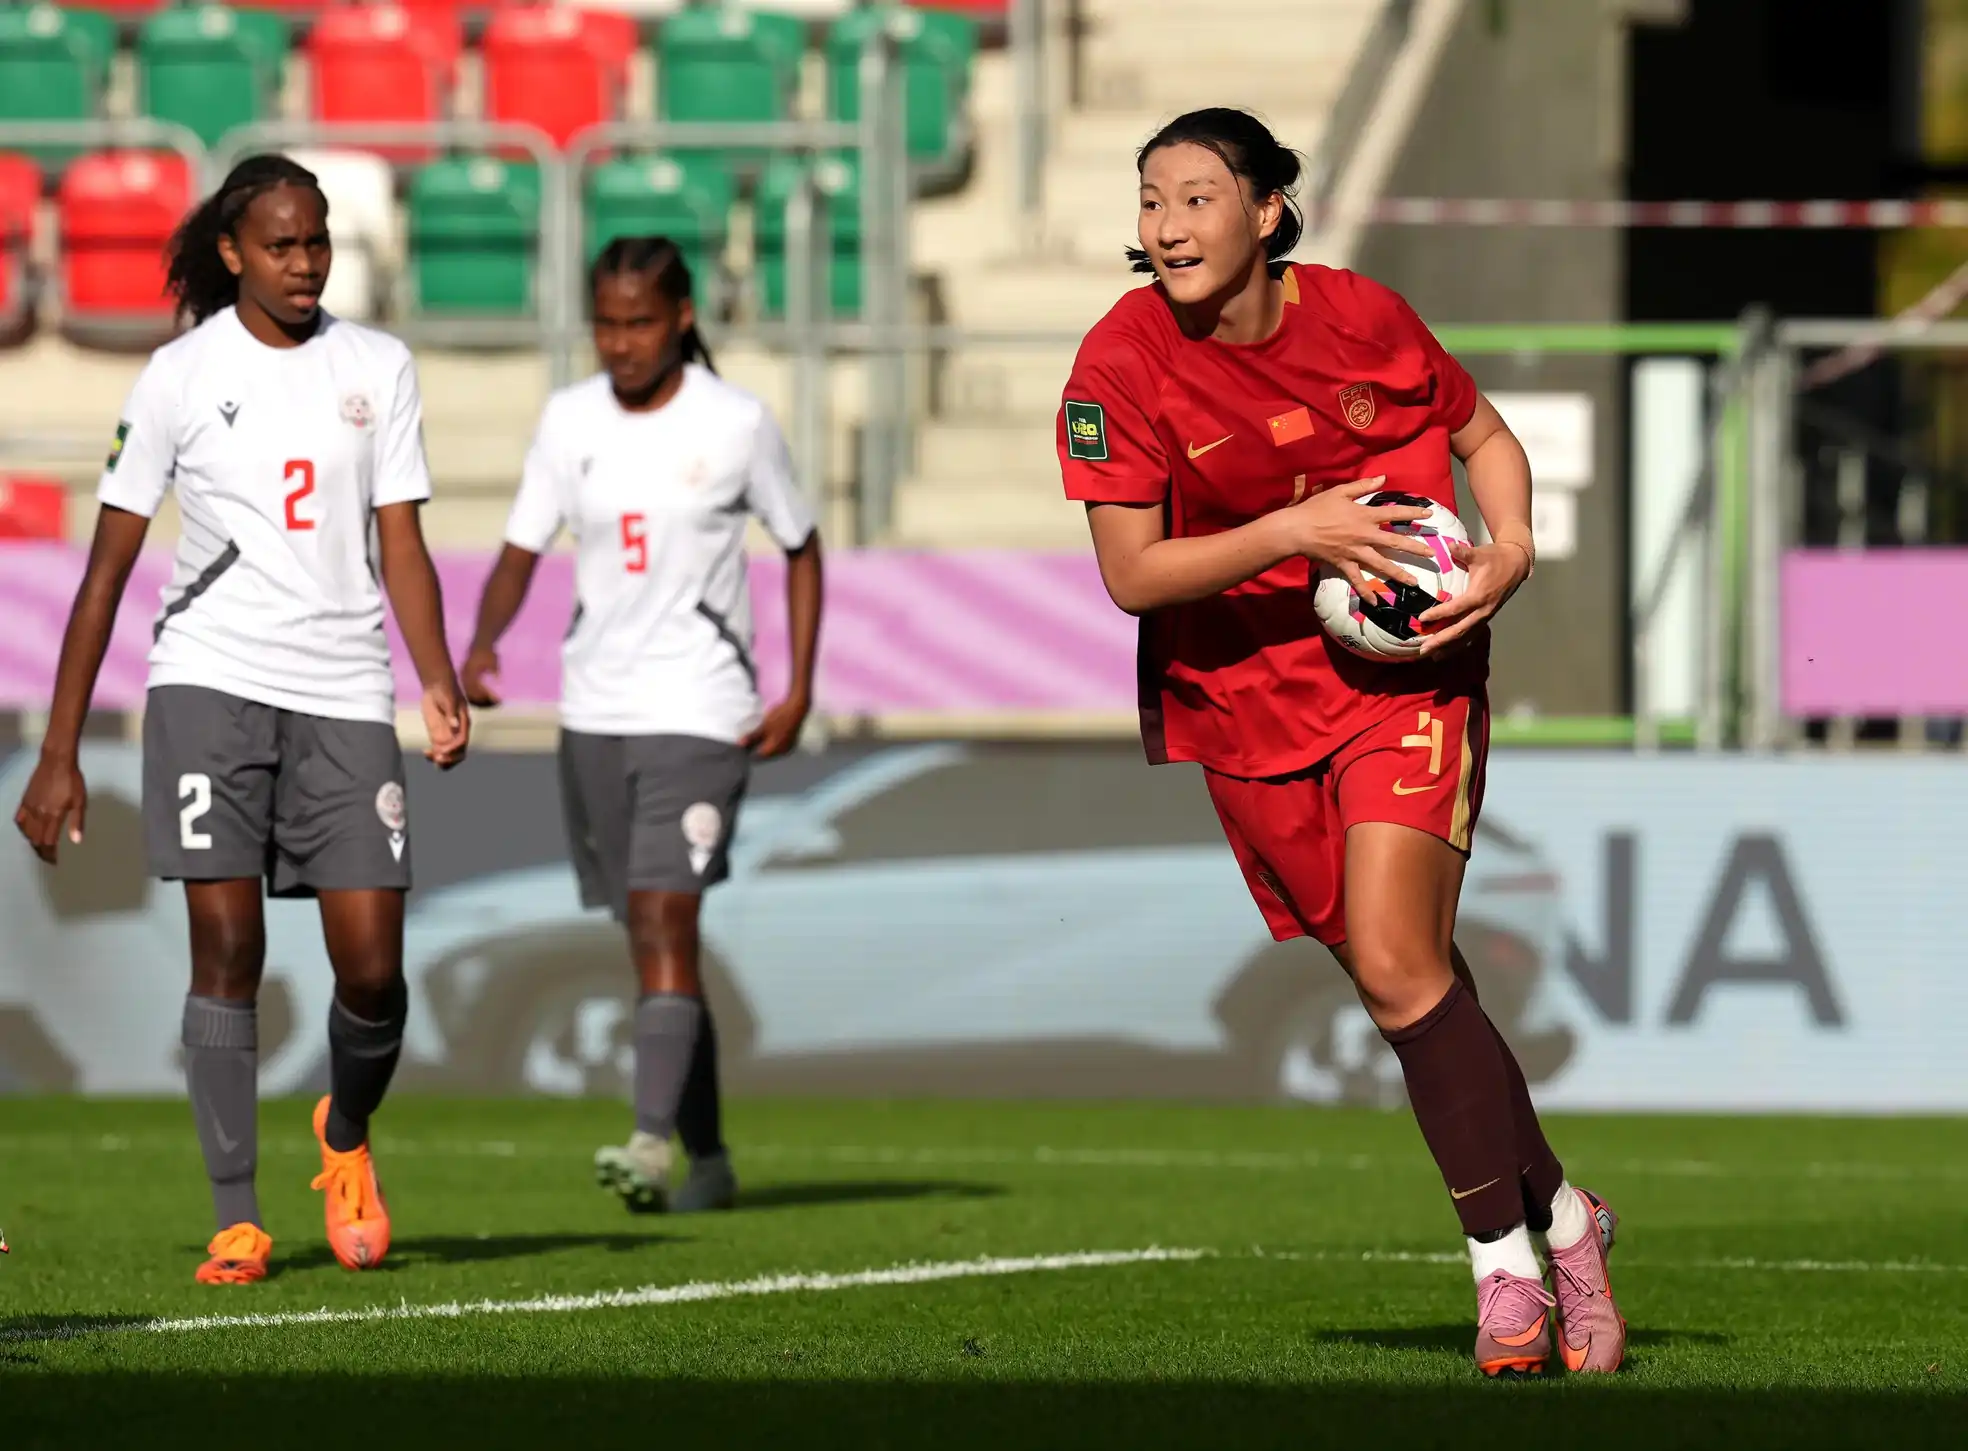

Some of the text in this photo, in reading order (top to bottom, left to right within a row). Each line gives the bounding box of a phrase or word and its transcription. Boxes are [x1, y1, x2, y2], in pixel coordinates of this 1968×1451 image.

[1341, 384, 1369, 400] CFA
[284, 459, 315, 530] 2
[621, 513, 646, 573] 5
[1401, 711, 1444, 775] 4
[178, 772, 212, 849] 2
